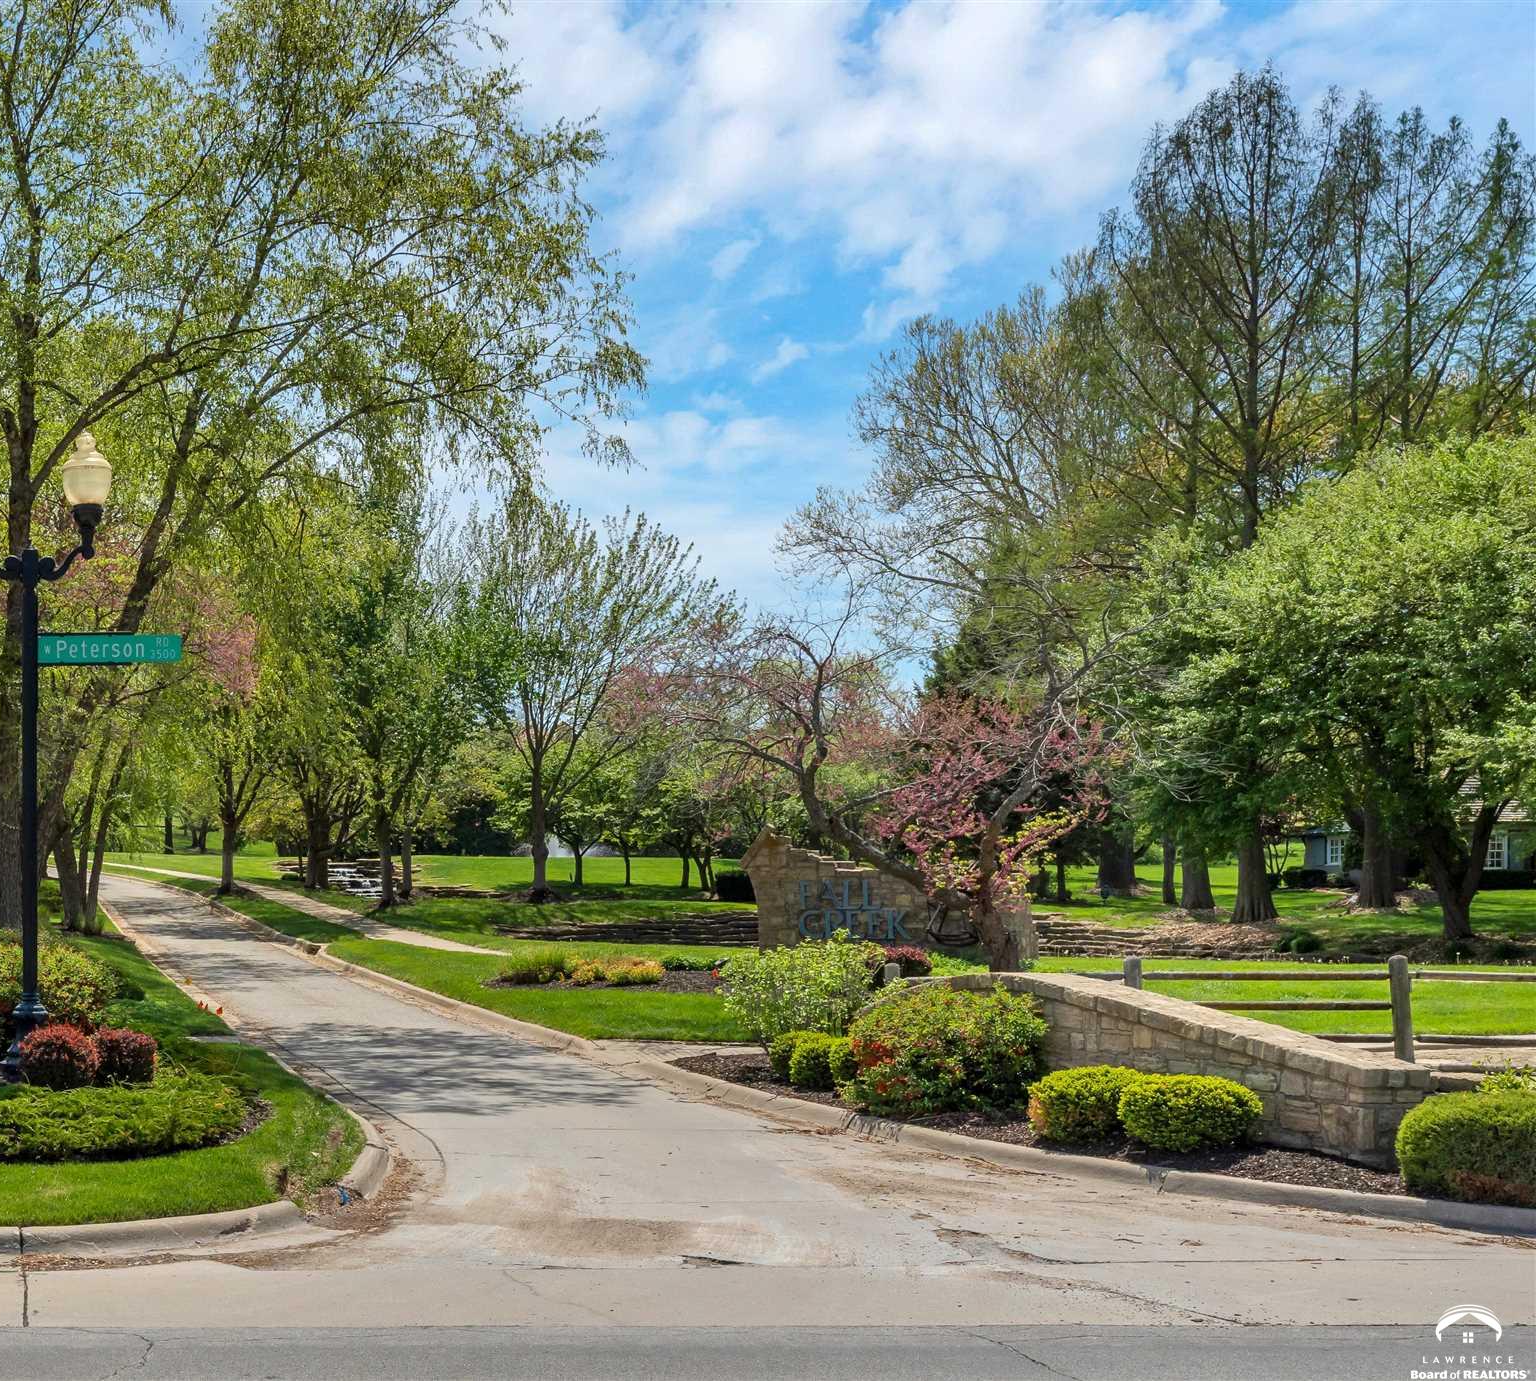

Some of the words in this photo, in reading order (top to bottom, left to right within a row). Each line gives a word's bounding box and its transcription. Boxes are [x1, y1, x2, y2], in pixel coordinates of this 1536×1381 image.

[44, 644, 51, 655] W
[56, 640, 145, 658] Peterson
[156, 637, 169, 648] RD
[151, 649, 176, 659] 3500
[799, 879, 881, 910] FALL
[799, 909, 913, 940] CREEK
